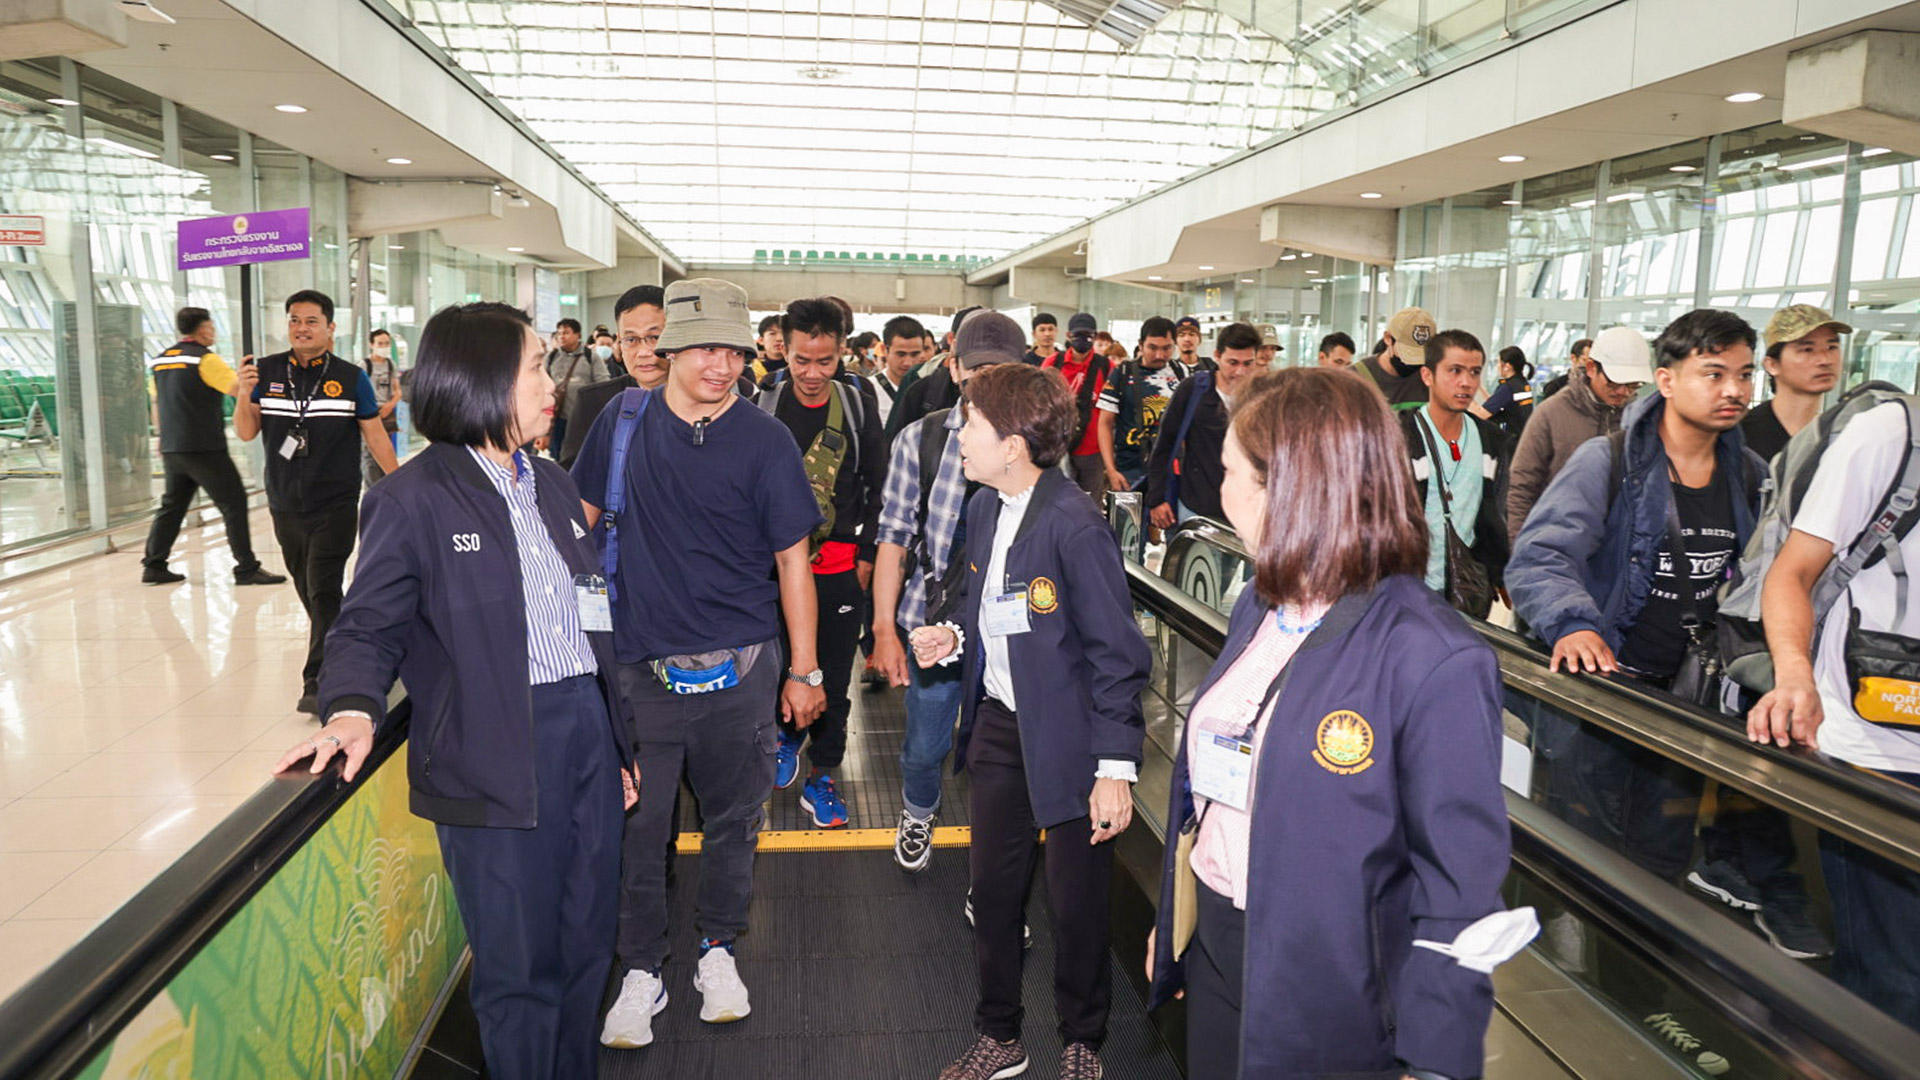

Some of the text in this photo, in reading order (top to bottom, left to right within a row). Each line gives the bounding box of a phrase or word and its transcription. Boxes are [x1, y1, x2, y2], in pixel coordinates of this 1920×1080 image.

[452, 533, 481, 552] SSO
[674, 675, 728, 695] GMT
[1881, 692, 1920, 705] NOR
[1893, 702, 1920, 716] FAC
